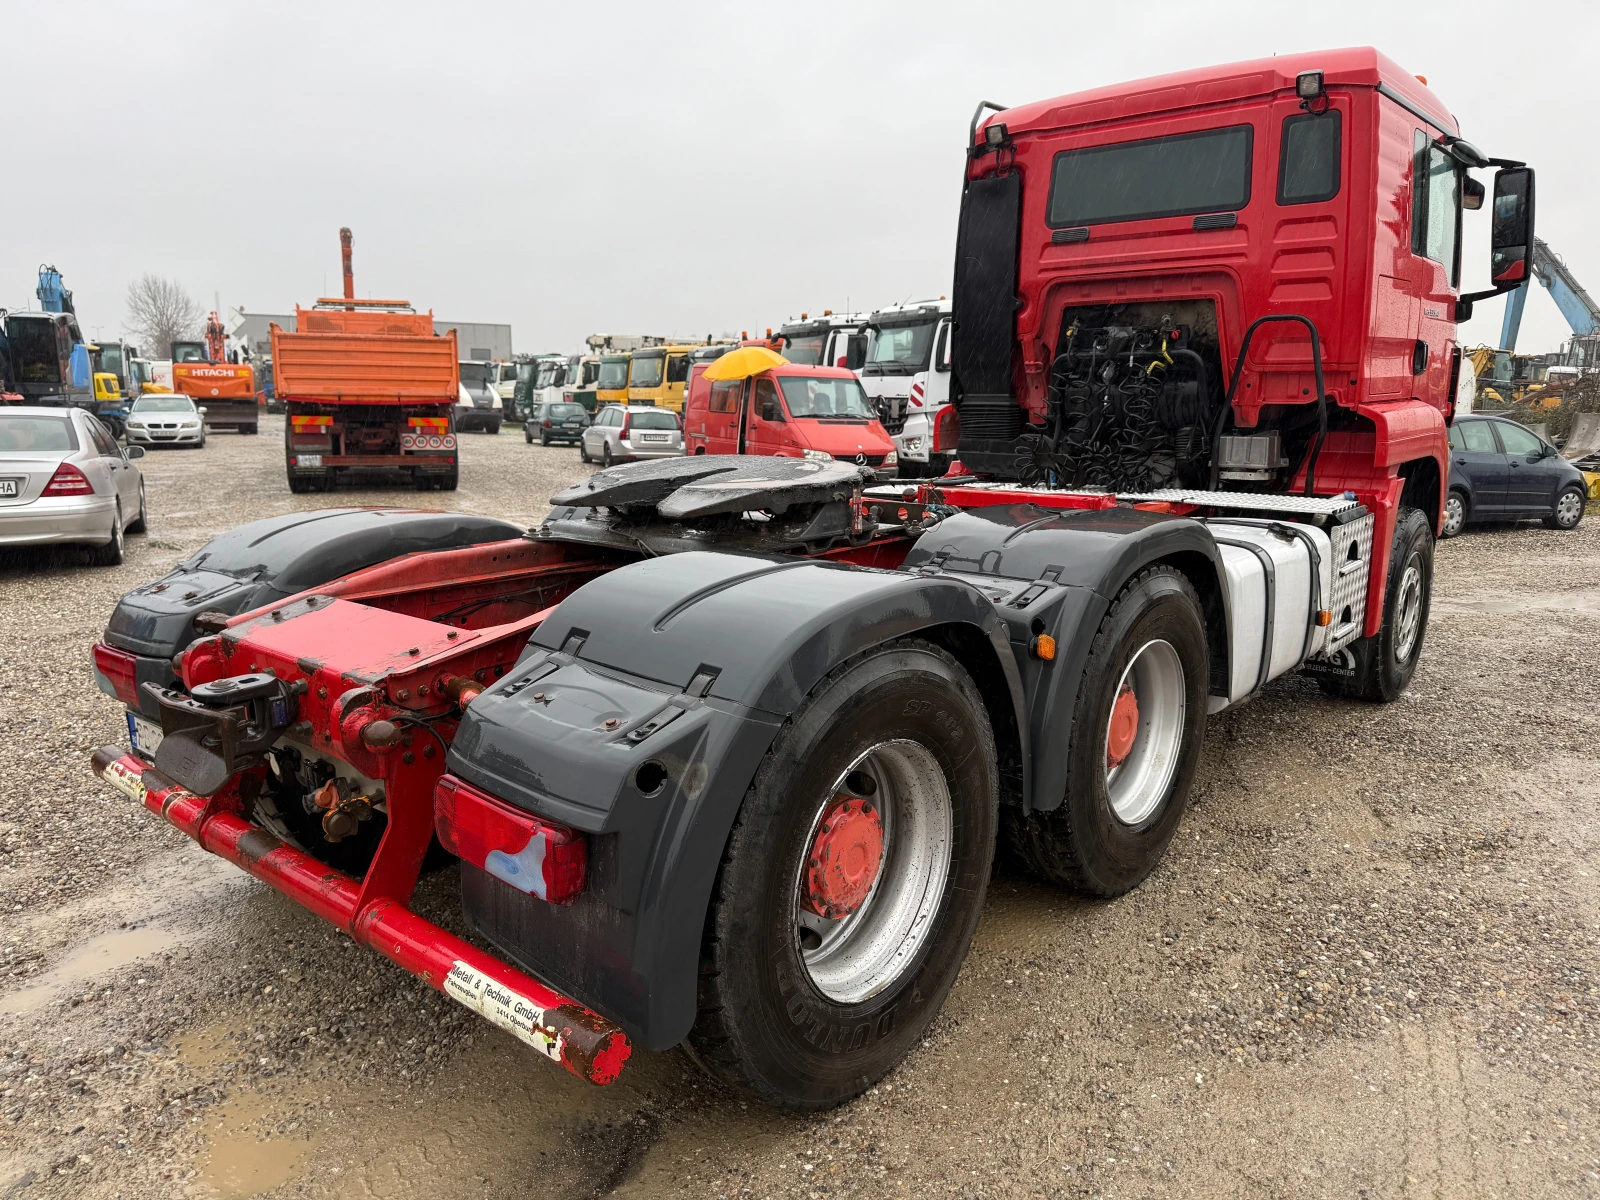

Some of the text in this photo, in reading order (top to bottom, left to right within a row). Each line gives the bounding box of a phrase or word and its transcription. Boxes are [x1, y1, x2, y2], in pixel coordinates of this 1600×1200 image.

[192, 369, 234, 377] HITACHI
[1332, 667, 1355, 677] CENTER
[450, 966, 540, 1023] Metall & Technik GmbH
[496, 1006, 510, 1020] 3414
[776, 962, 898, 1054] DUNLOP
